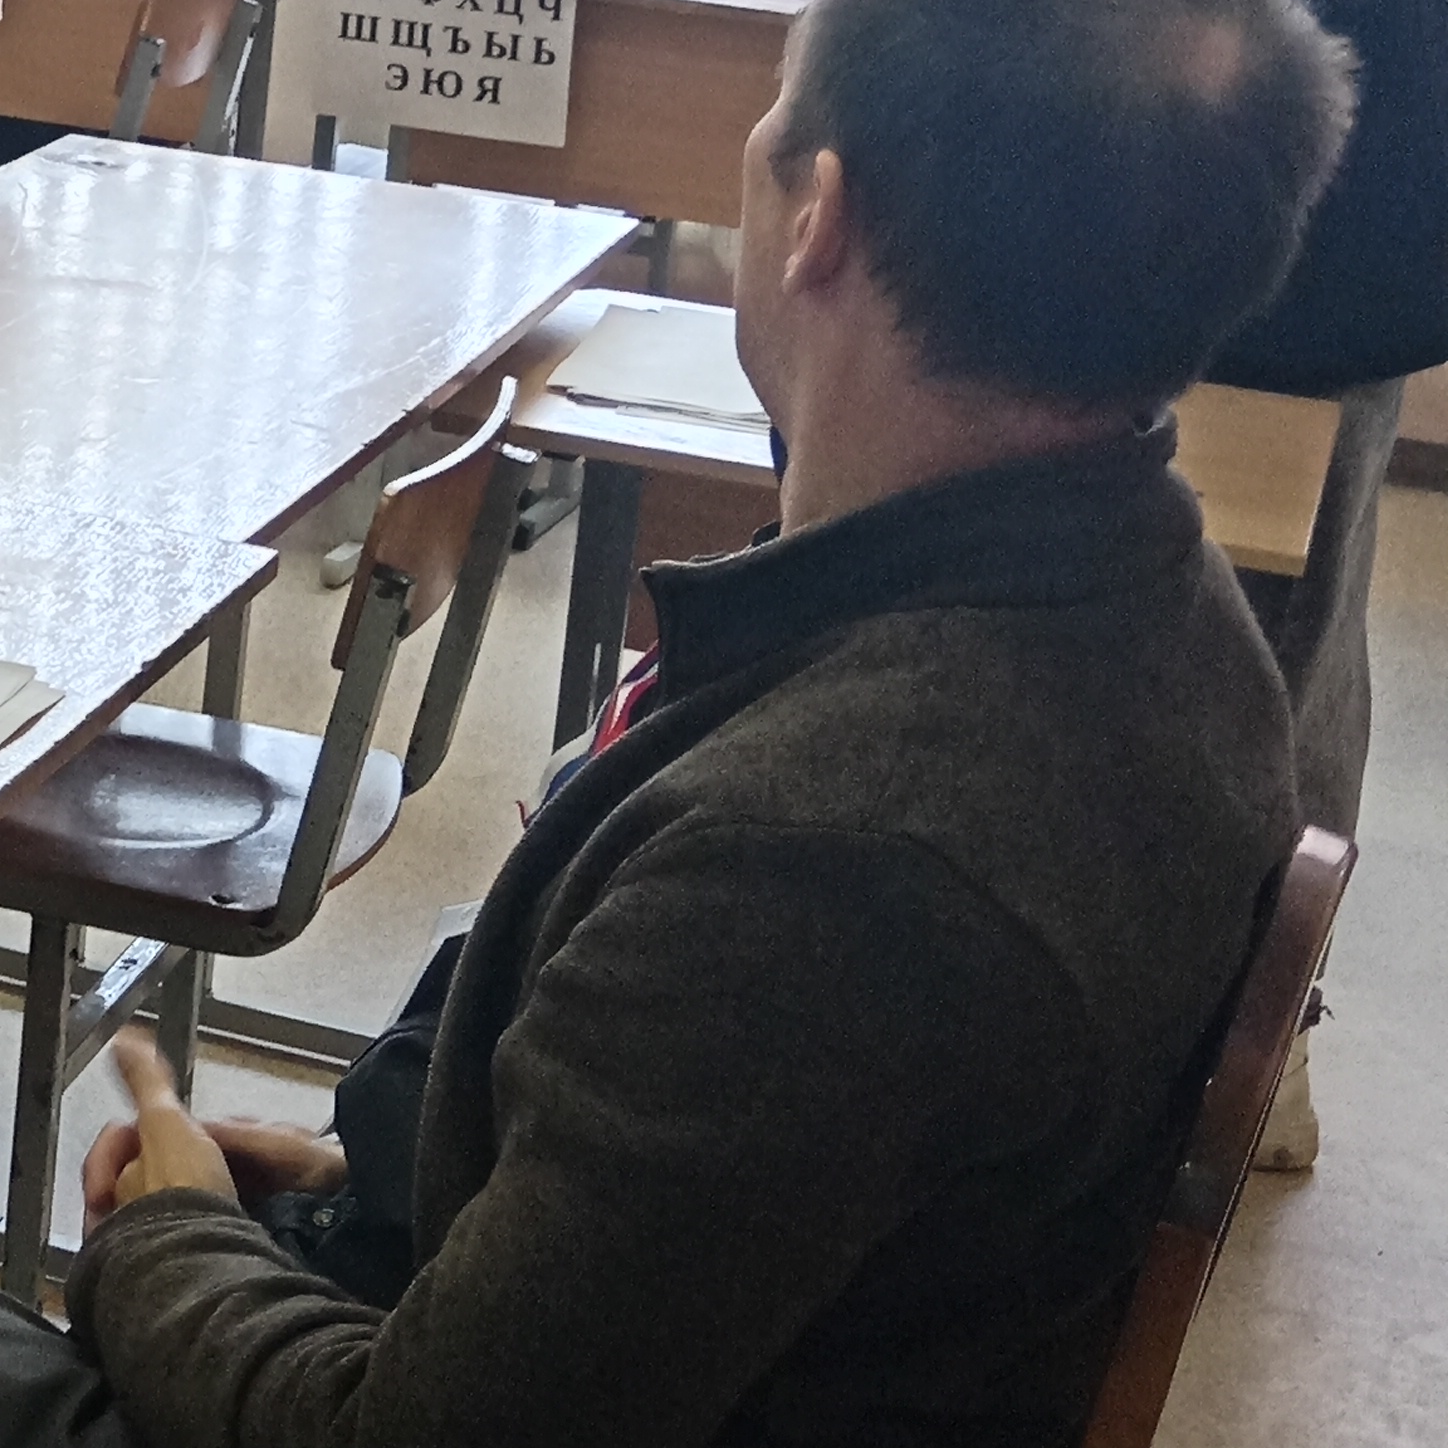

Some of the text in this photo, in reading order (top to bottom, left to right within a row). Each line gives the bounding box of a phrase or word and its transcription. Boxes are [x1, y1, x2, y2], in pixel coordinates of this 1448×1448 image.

[337, 11, 556, 65] Ш Щ Ъ Ы Ь
[385, 63, 503, 104] Э Ю Я
